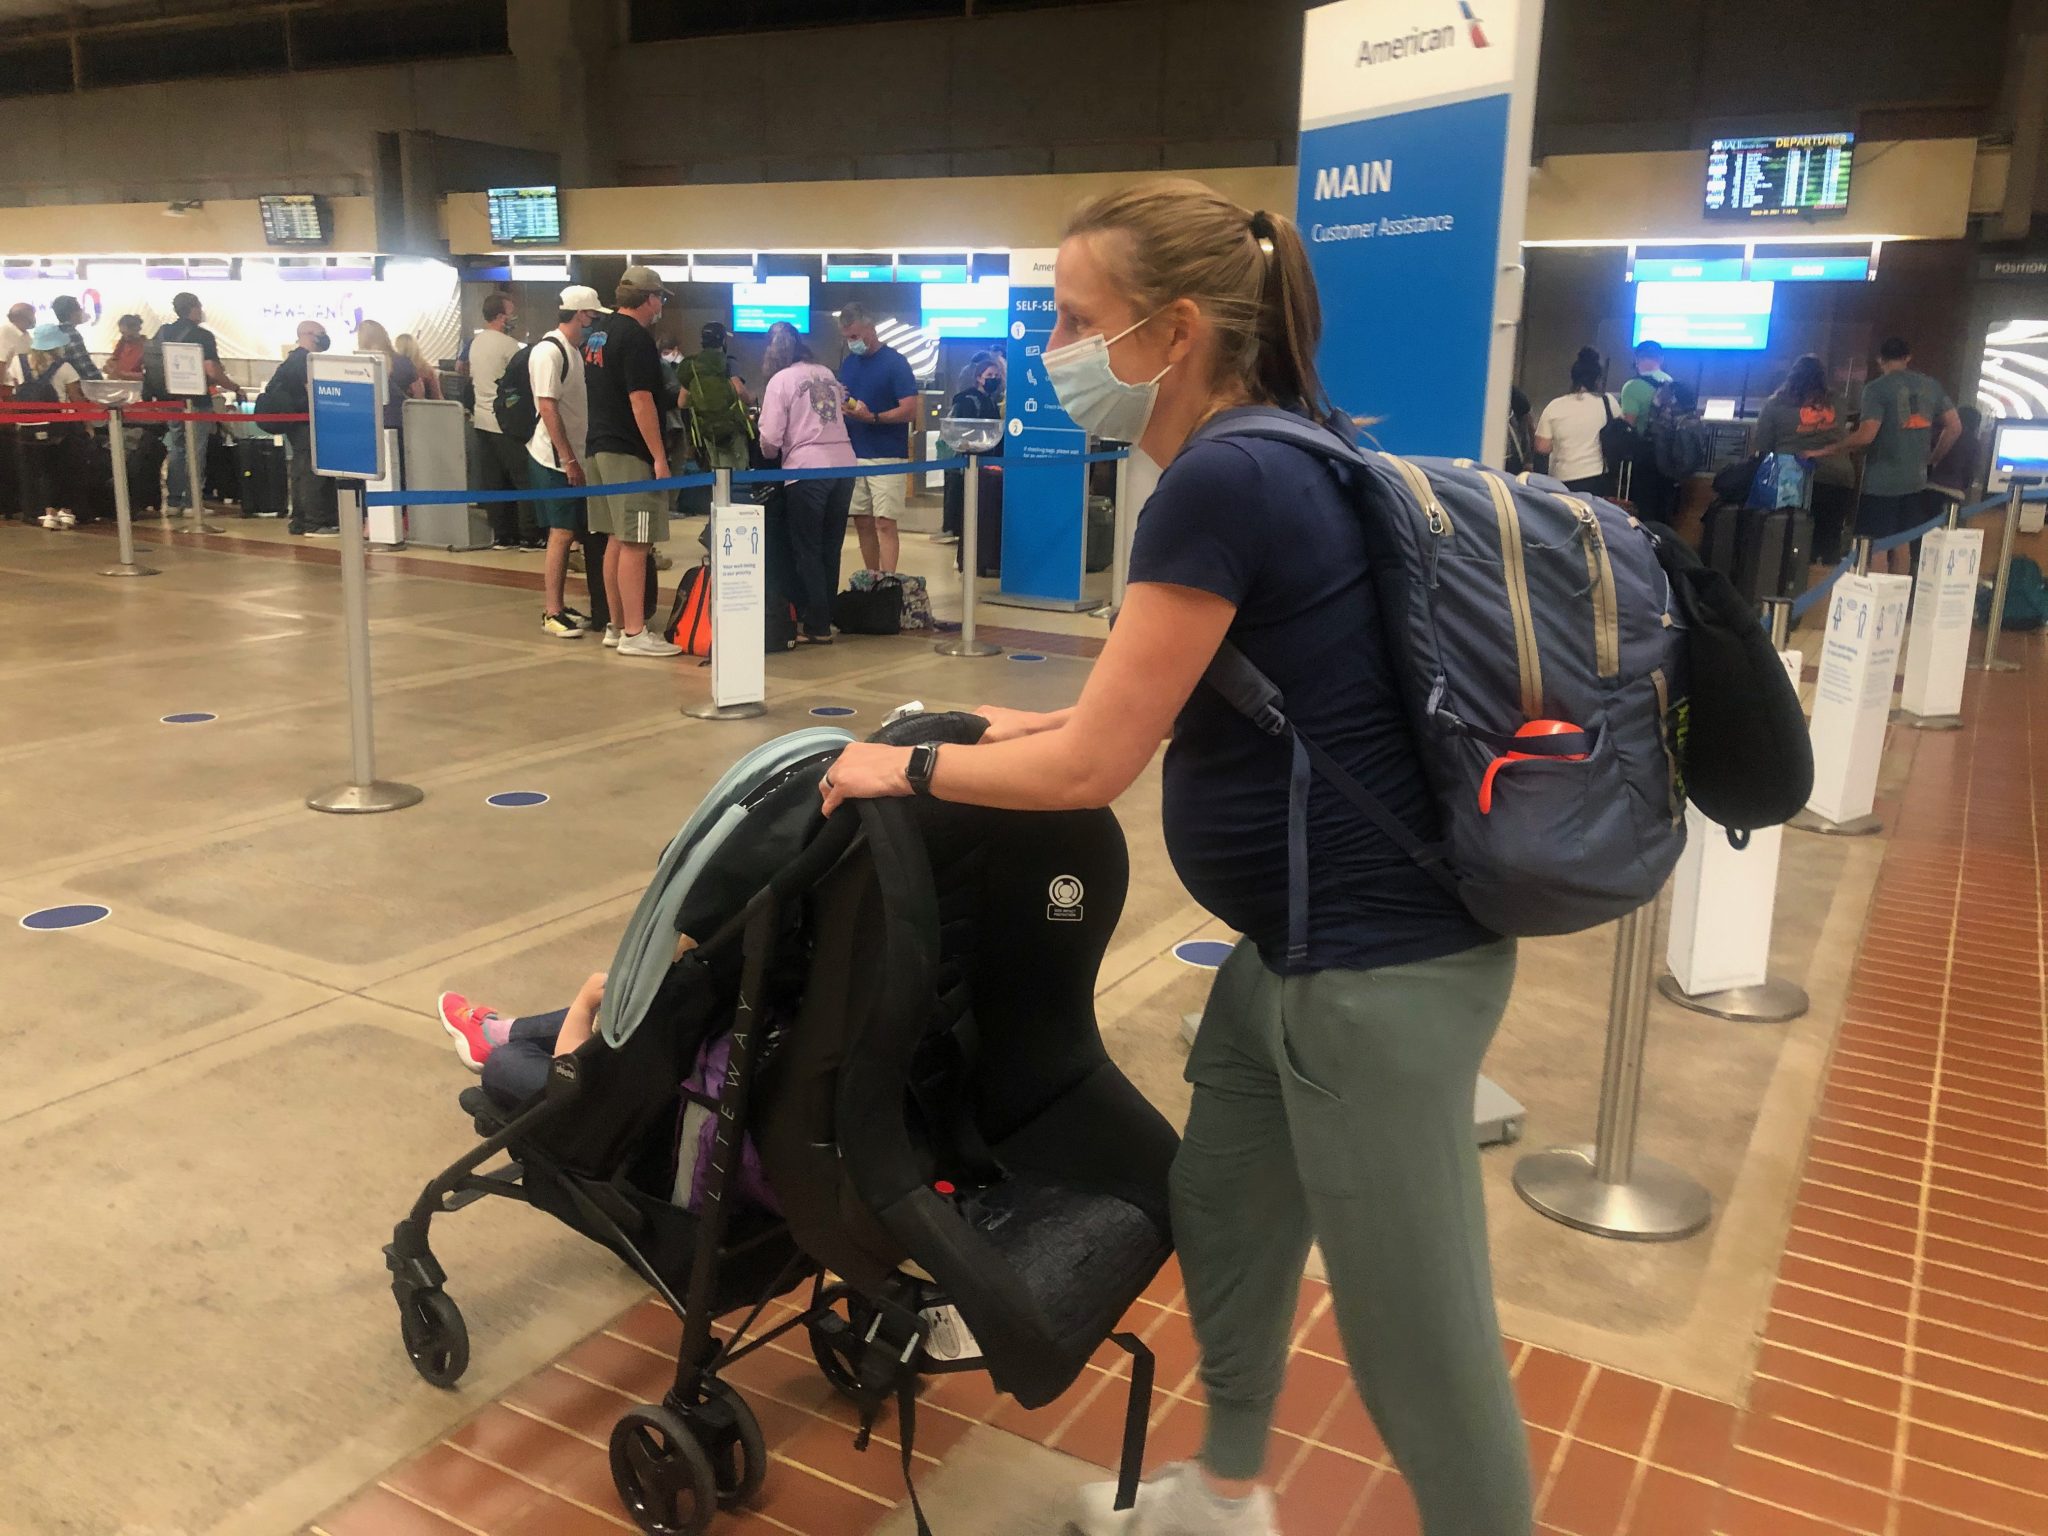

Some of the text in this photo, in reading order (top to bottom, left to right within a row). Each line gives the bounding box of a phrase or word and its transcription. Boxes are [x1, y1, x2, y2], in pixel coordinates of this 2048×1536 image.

[1355, 25, 1455, 67] American
[1776, 134, 1847, 149] DEPARTURES
[1314, 159, 1393, 201] MAIN
[1311, 214, 1454, 243] Customer Assistance
[1033, 262, 1056, 271] Amer
[1995, 262, 2048, 273] POSITION
[318, 386, 342, 397] MAIN
[708, 991, 752, 1202] LITEWAY
